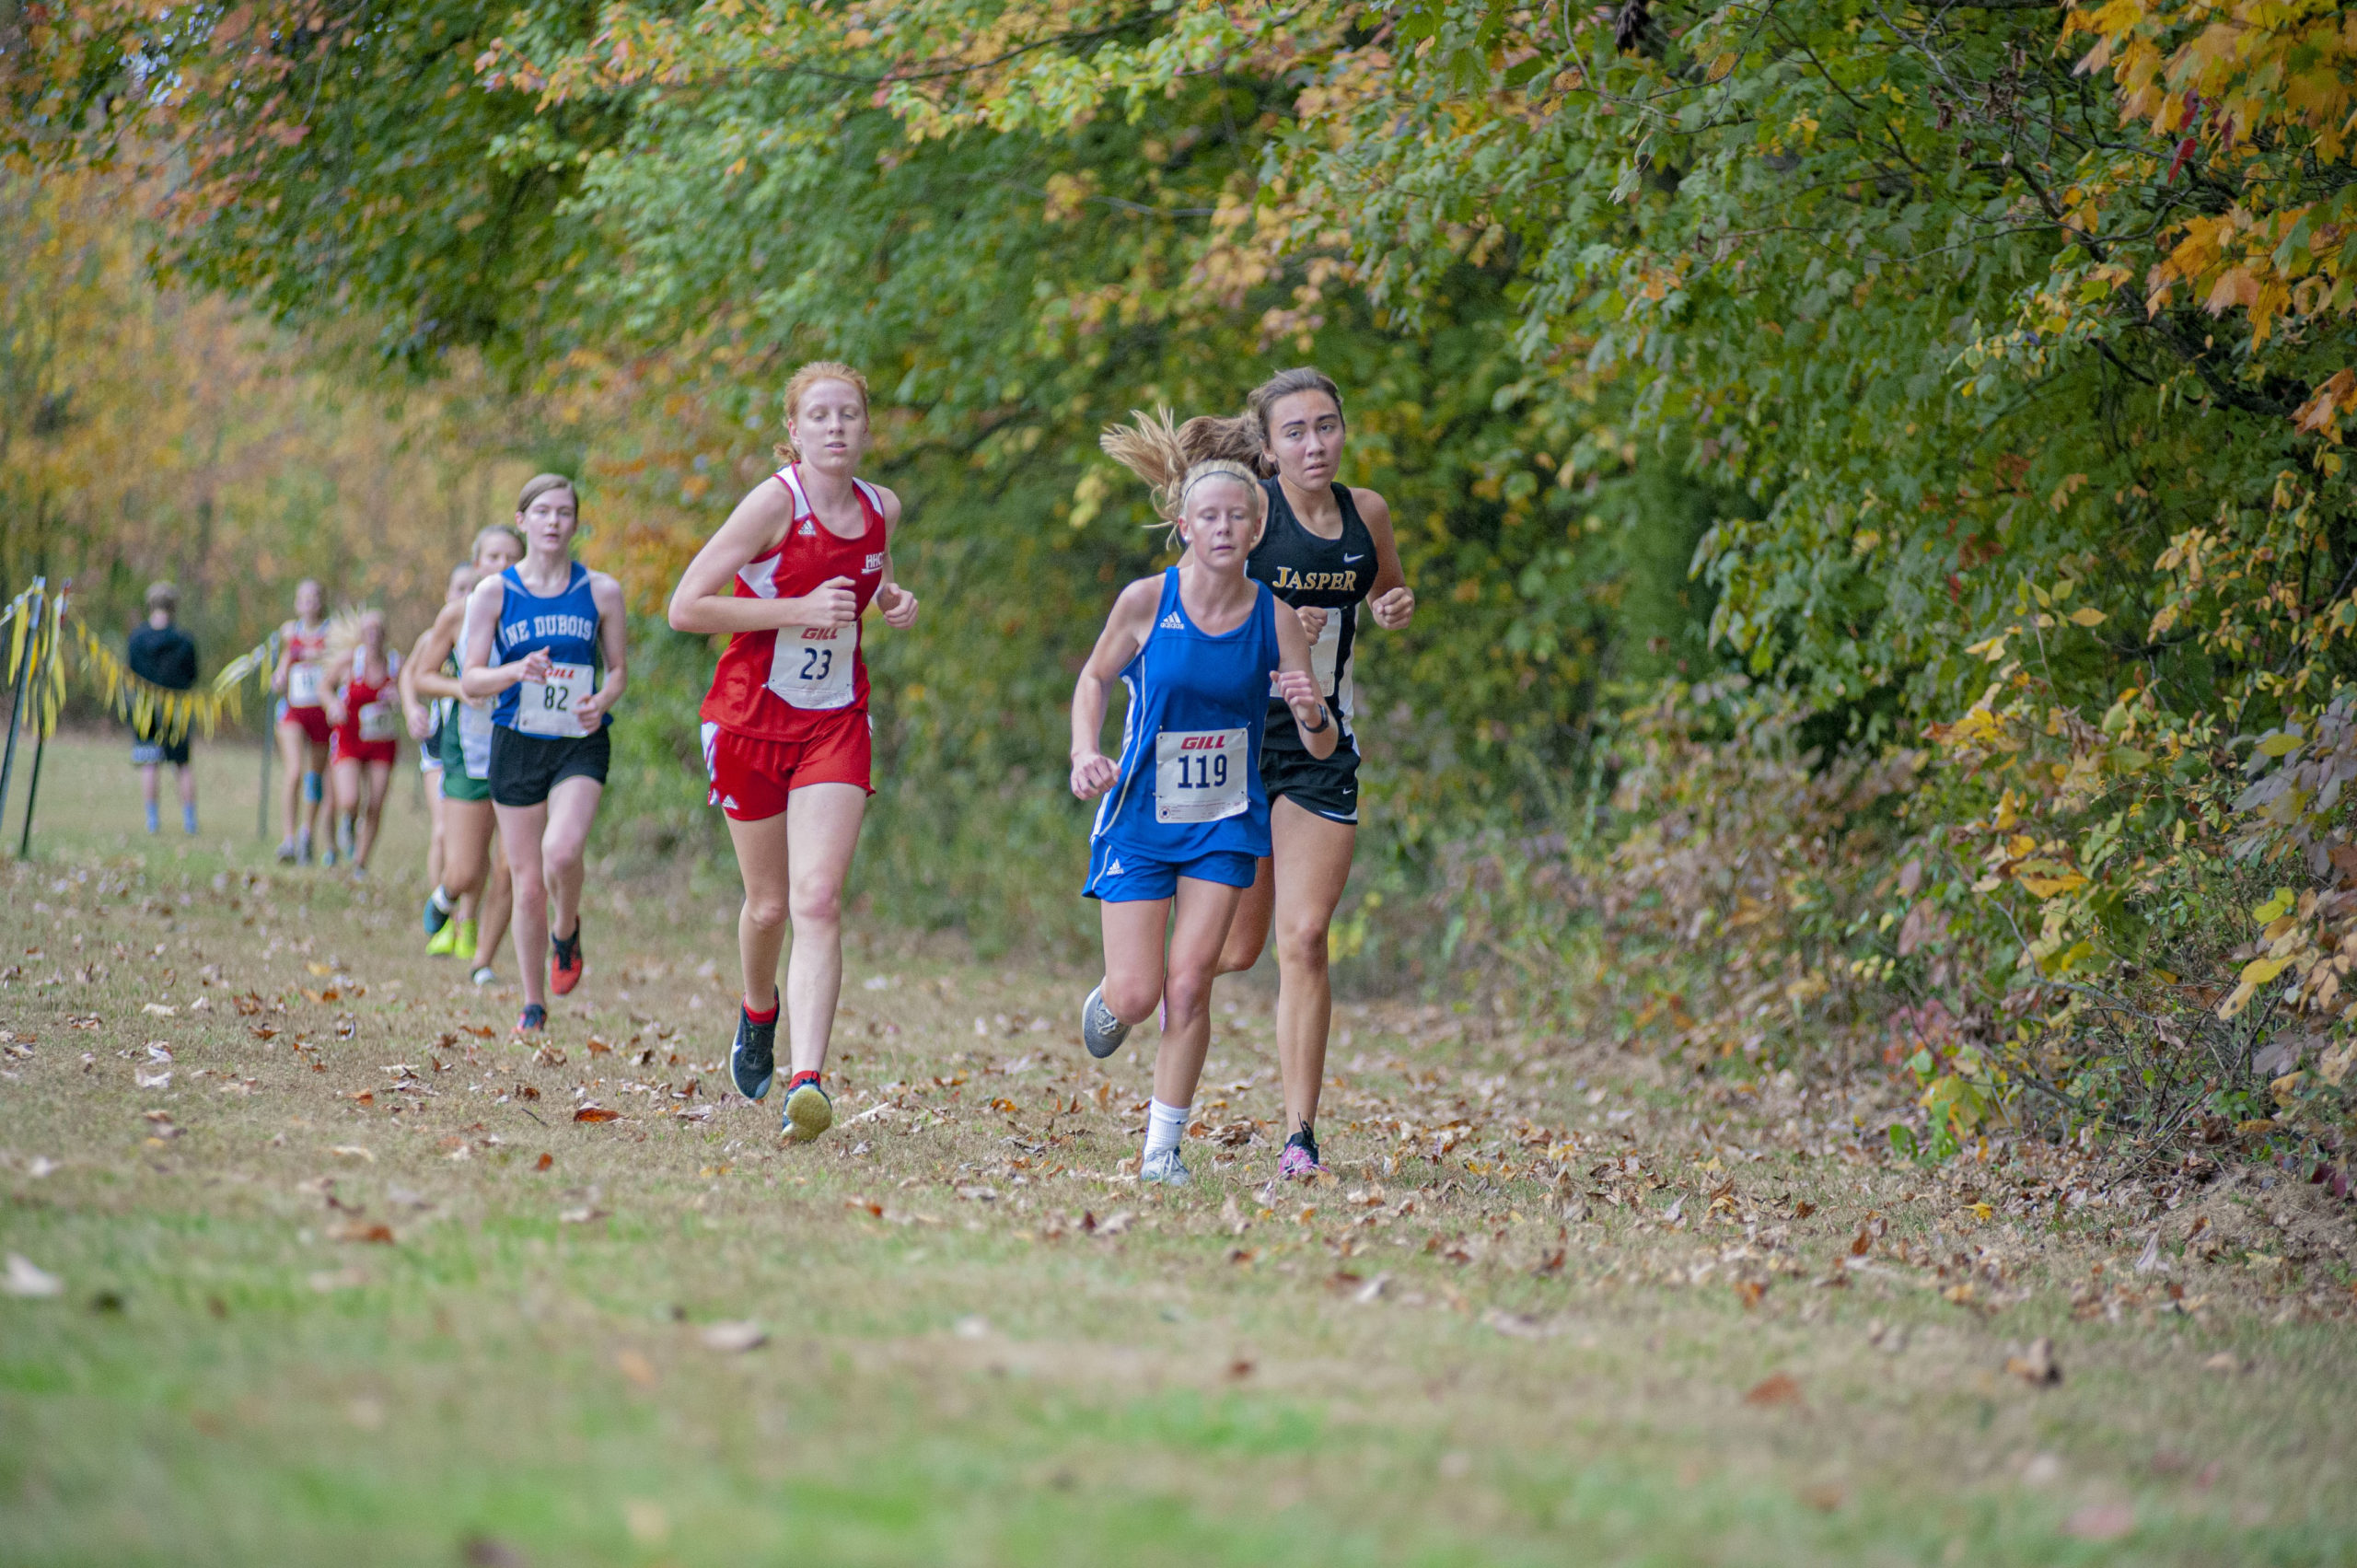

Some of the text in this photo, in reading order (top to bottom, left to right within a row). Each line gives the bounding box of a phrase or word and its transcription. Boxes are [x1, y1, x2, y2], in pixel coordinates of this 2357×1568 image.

[1272, 565, 1357, 591] JASPER
[505, 614, 594, 646] NE DUBOIS
[801, 627, 838, 640] GILL
[799, 647, 832, 680] 23
[544, 686, 569, 711] 82
[1181, 736, 1225, 749] GILL
[1178, 754, 1228, 789] 119
